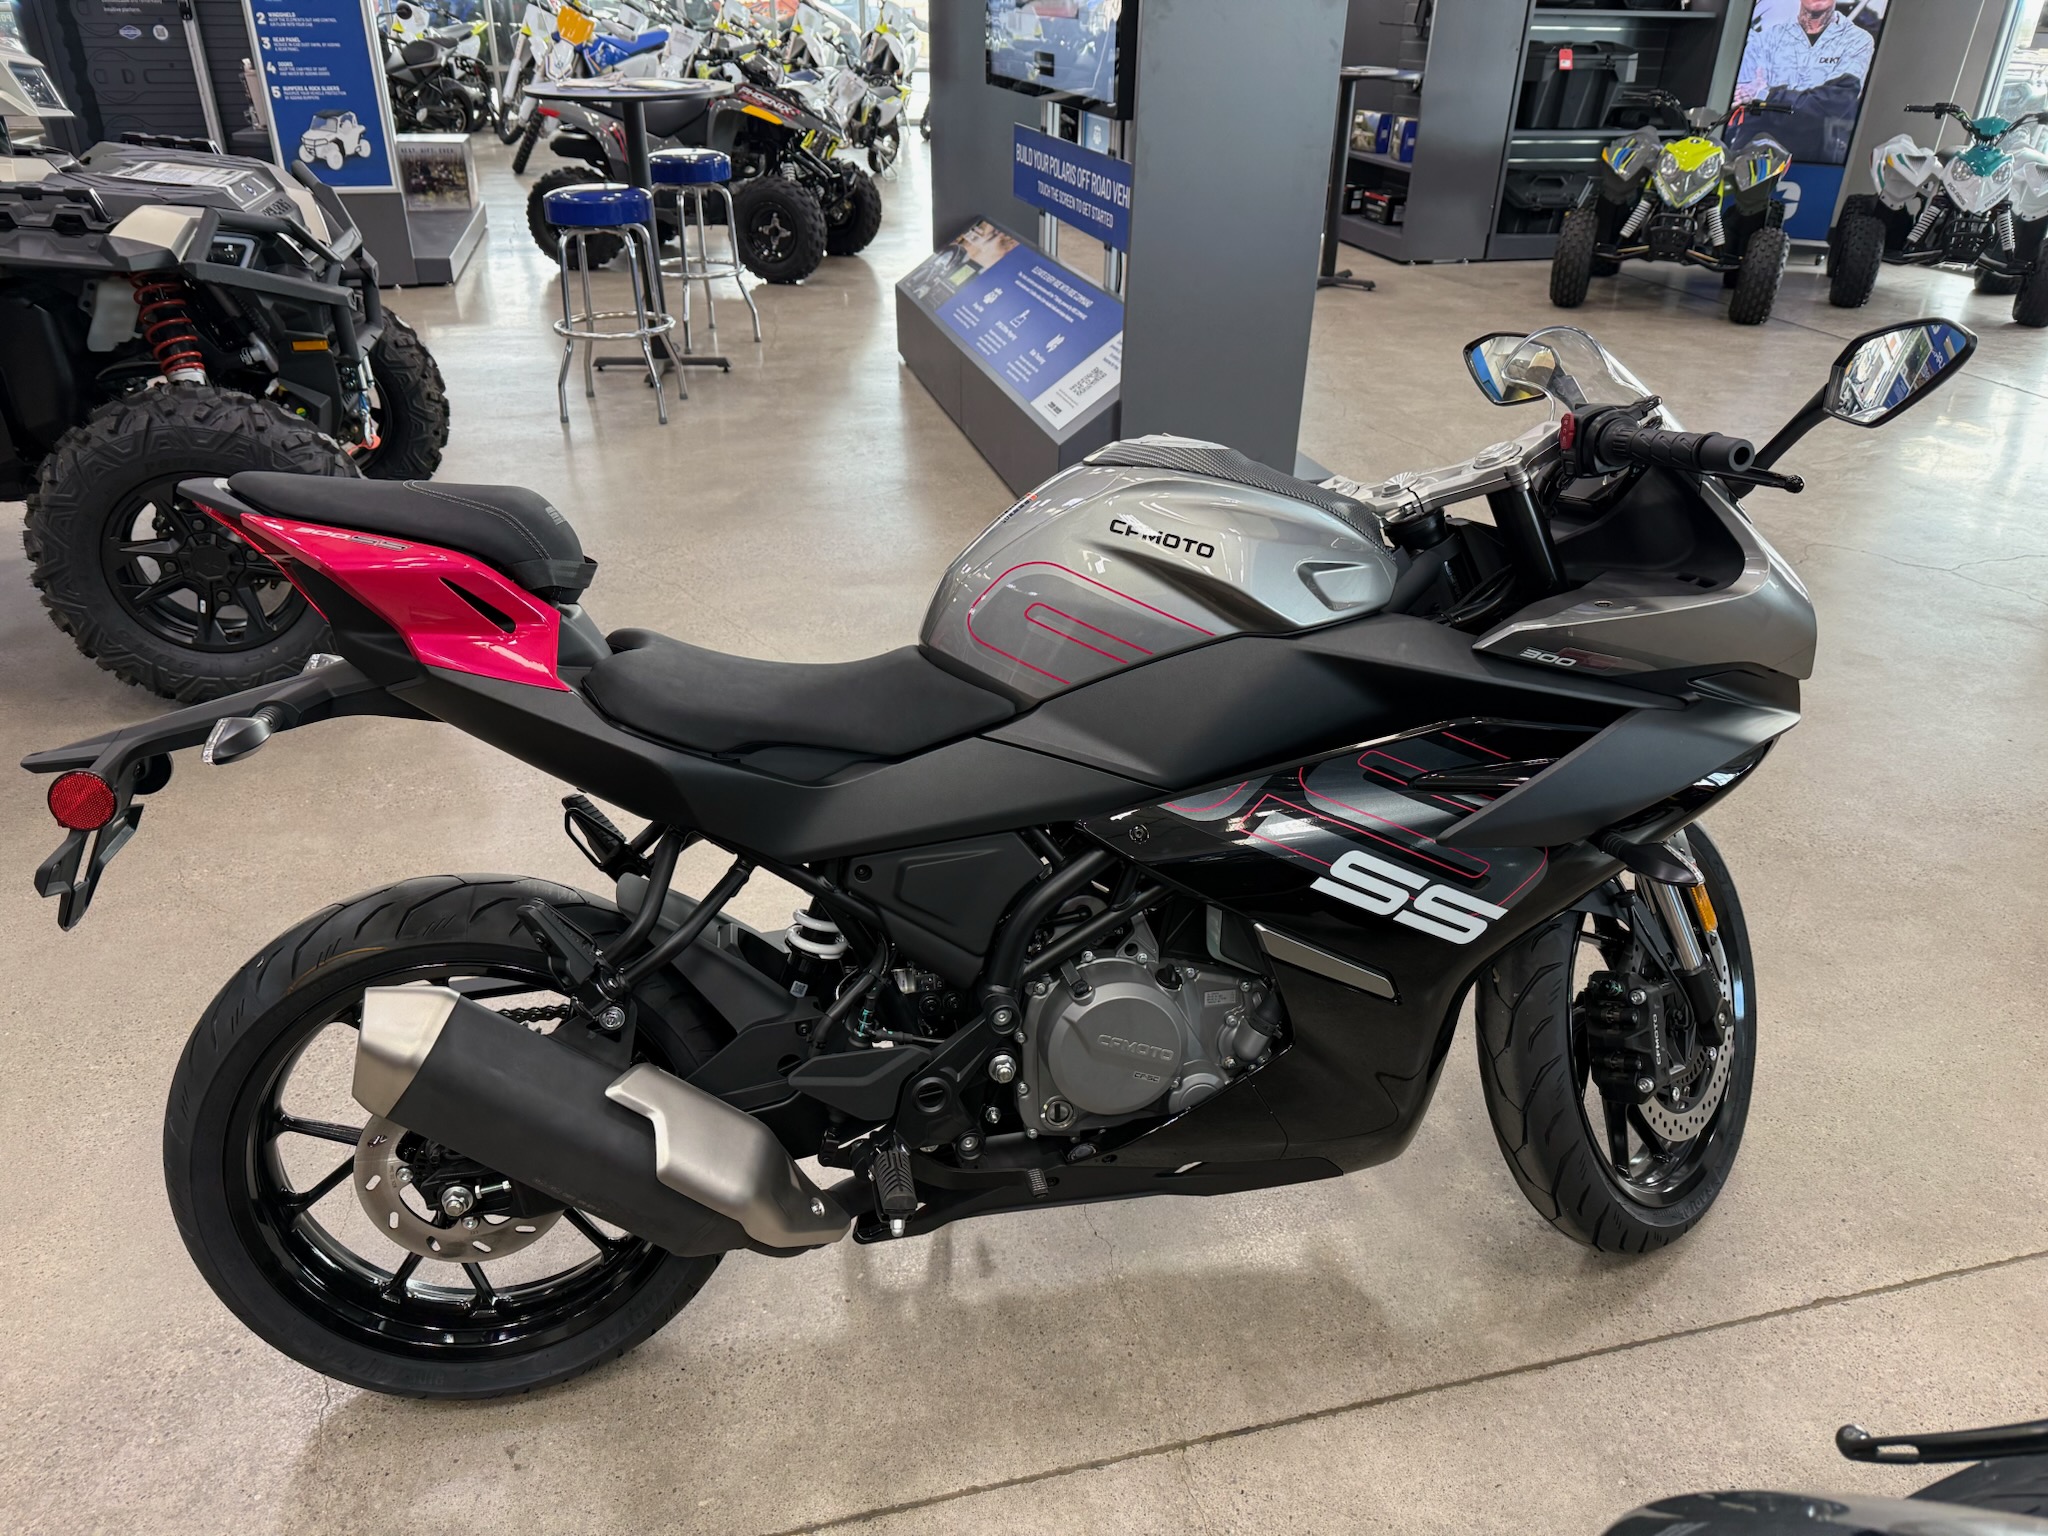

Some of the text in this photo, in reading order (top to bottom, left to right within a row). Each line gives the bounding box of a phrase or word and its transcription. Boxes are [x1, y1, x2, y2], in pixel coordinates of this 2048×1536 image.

[256, 12, 266, 25] 2
[261, 36, 271, 50] 3
[266, 62, 276, 74] 4
[271, 86, 281, 99] 5
[739, 86, 791, 115] PHOENIX
[1016, 143, 1033, 166] BUILD
[1034, 149, 1049, 174] YOUR
[1050, 156, 1076, 186] POLARIS
[1077, 167, 1091, 191] OFF
[1091, 172, 1112, 200] ROAD
[1038, 180, 1114, 229] TOUCH THE SCREEN TO GET STARTED
[1947, 182, 1967, 206] POLARIS
[1310, 850, 1509, 944] SS
[1098, 1034, 1174, 1061] CFMOTO
[1653, 1014, 1662, 1065] CFMOTO
